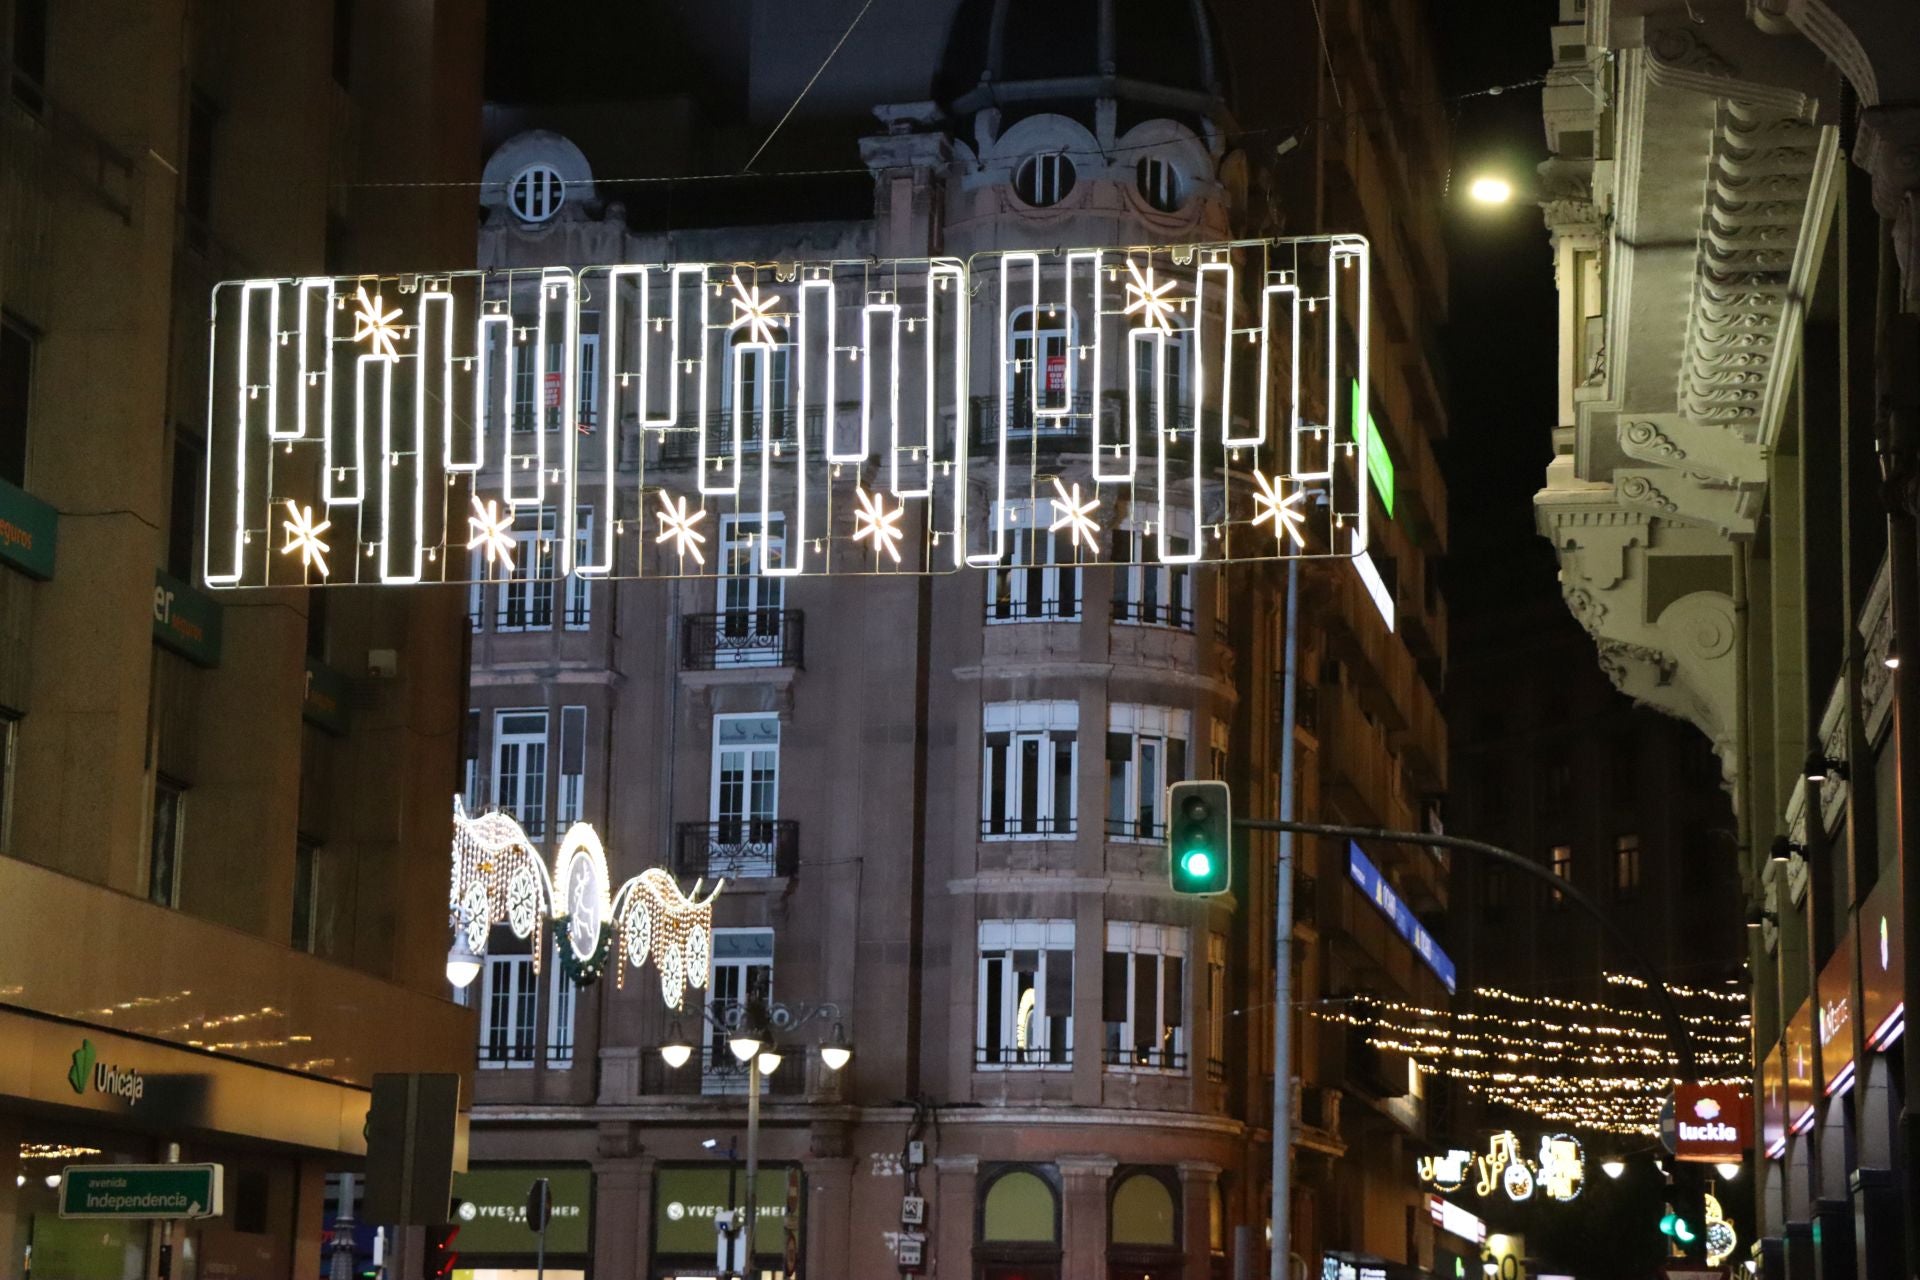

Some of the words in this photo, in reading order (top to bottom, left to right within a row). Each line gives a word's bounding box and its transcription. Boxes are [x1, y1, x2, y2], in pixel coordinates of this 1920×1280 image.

[96, 1062, 144, 1107] Unicaja
[1679, 1122, 1737, 1141] luckia
[88, 1177, 127, 1189] avenida
[86, 1192, 188, 1211] Independencia
[478, 1205, 516, 1217] YVES
[518, 1205, 581, 1217] RHER
